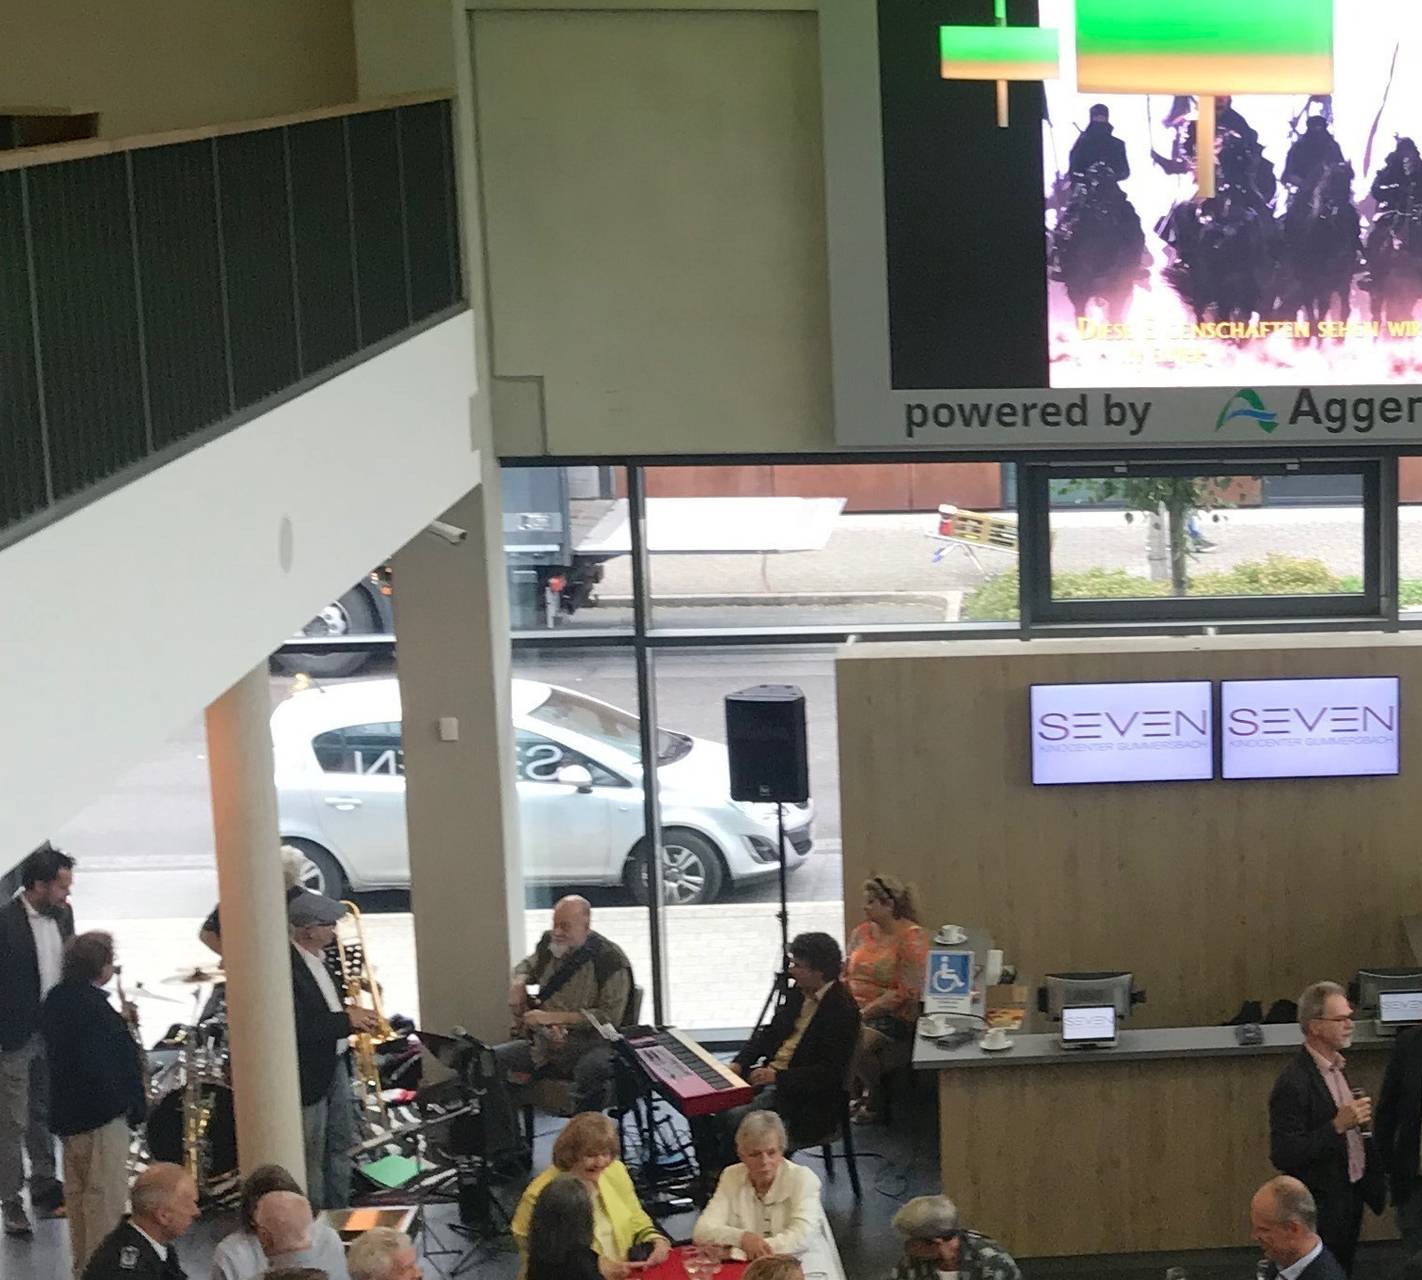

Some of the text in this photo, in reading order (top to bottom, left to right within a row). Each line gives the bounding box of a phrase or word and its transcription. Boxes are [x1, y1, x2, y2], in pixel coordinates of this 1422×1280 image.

[904, 393, 1088, 438] powered
[1103, 393, 1152, 436] by
[1038, 710, 1207, 741] SEVEN
[1228, 706, 1394, 736] SEVEN
